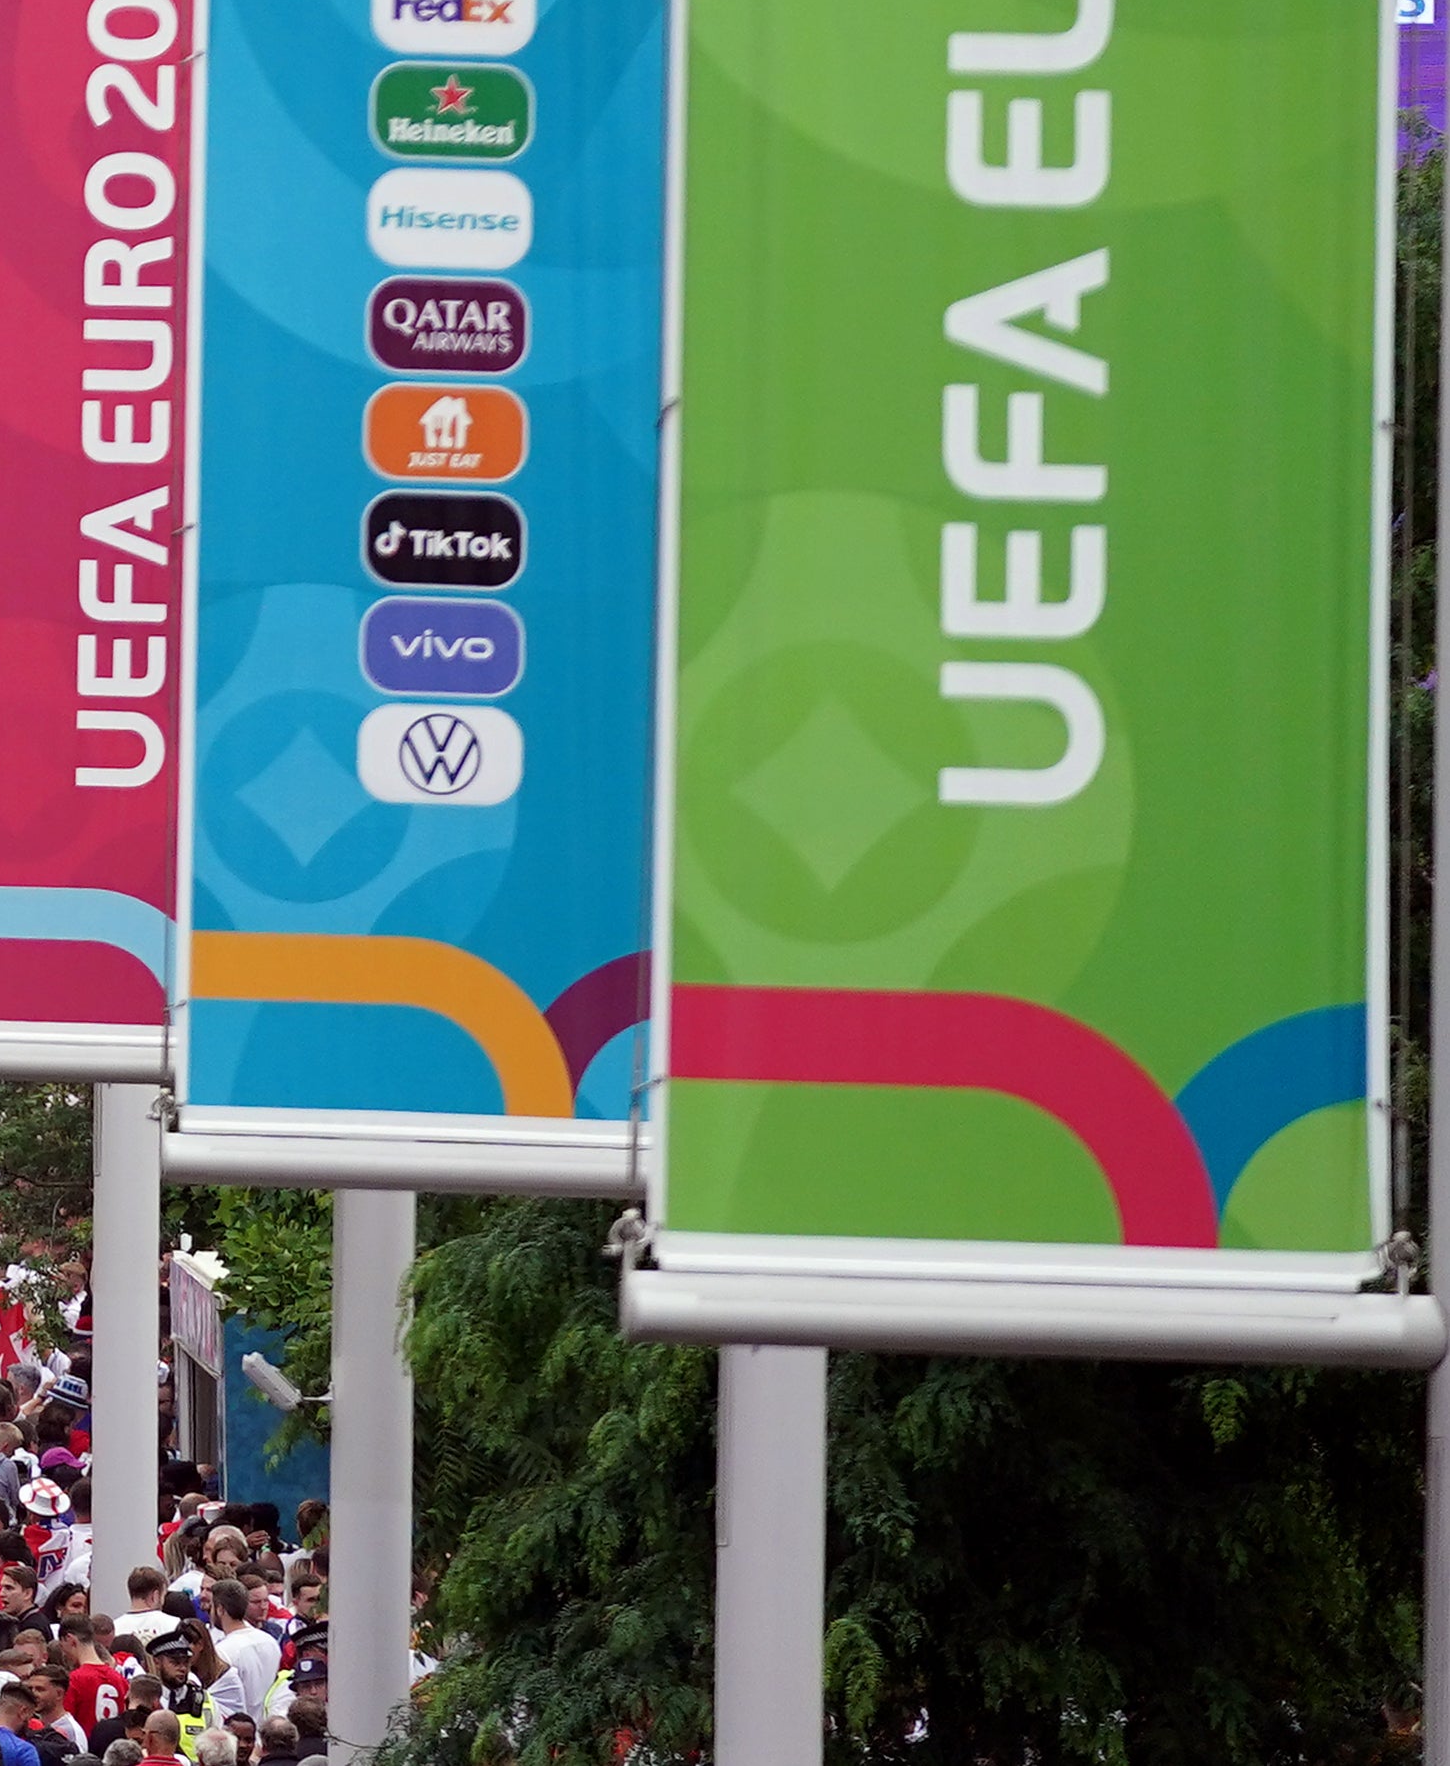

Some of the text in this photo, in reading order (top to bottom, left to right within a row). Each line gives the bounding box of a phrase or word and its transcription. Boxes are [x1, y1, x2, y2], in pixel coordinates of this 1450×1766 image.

[387, 117, 516, 147] Heineken
[379, 204, 520, 233] Hisense
[81, 151, 176, 464] EURO
[382, 297, 514, 335] QATAR
[411, 331, 515, 355] AIRWAYS
[407, 451, 483, 470] JUST EAT
[937, 246, 1111, 807] UEFA
[408, 528, 513, 560] TikTok
[75, 484, 172, 789] UEFA
[390, 628, 496, 661] vivo
[95, 1684, 119, 1722] 6
